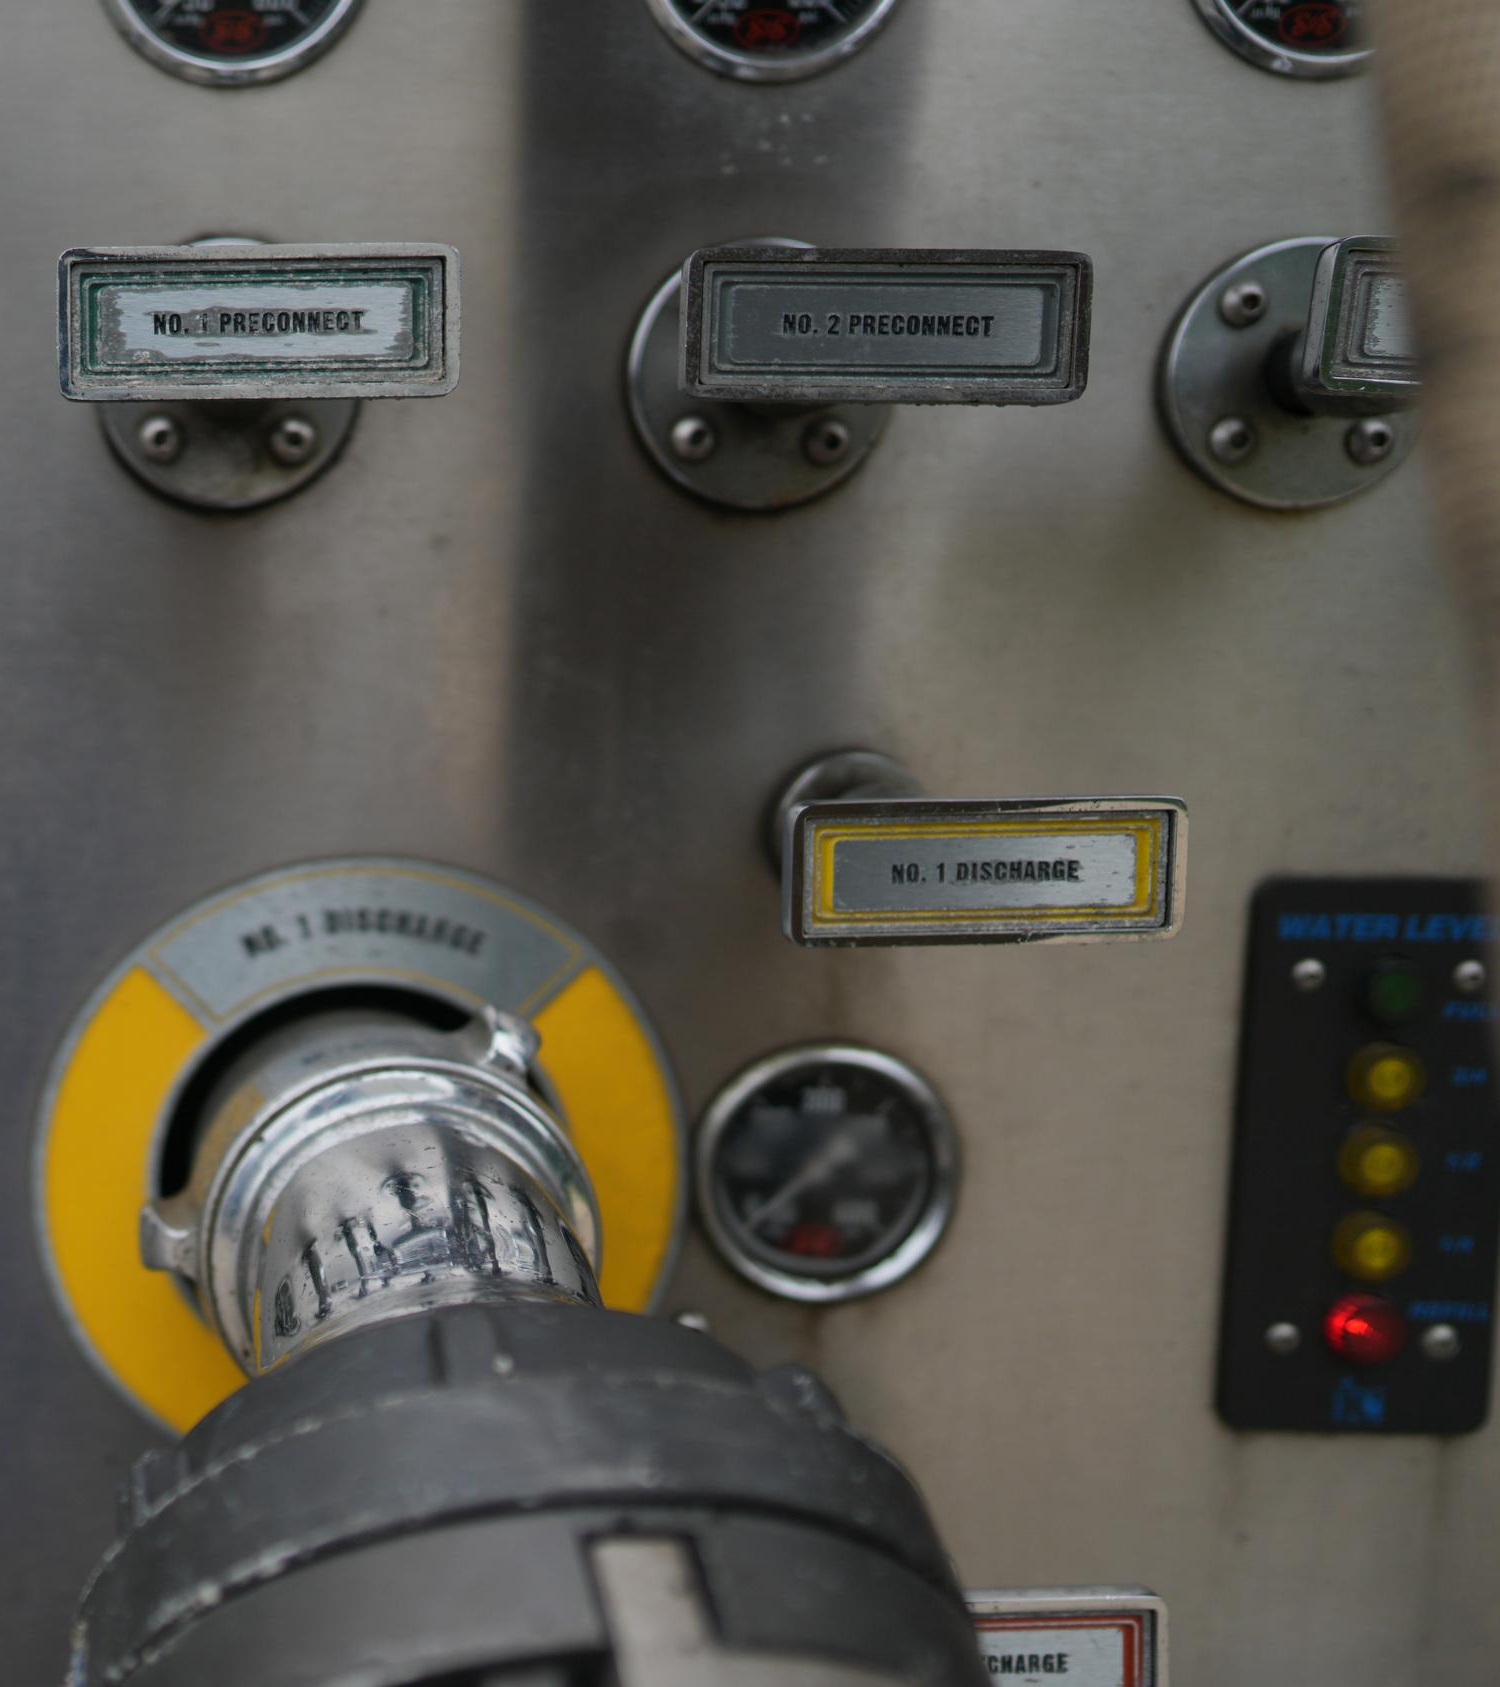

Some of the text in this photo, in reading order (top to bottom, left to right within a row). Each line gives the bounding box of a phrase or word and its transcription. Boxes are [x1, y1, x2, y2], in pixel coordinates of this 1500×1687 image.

[153, 313, 190, 335] NO.
[220, 310, 364, 335] PRECONNECT
[782, 314, 995, 338] NO. 2 PRECONNECT
[892, 859, 1079, 884] NO. 1 DISCHARGE
[323, 907, 486, 956] DISCHARGE
[1278, 913, 1500, 942] WATER LEVE
[986, 1652, 1070, 1674] CHARGE
